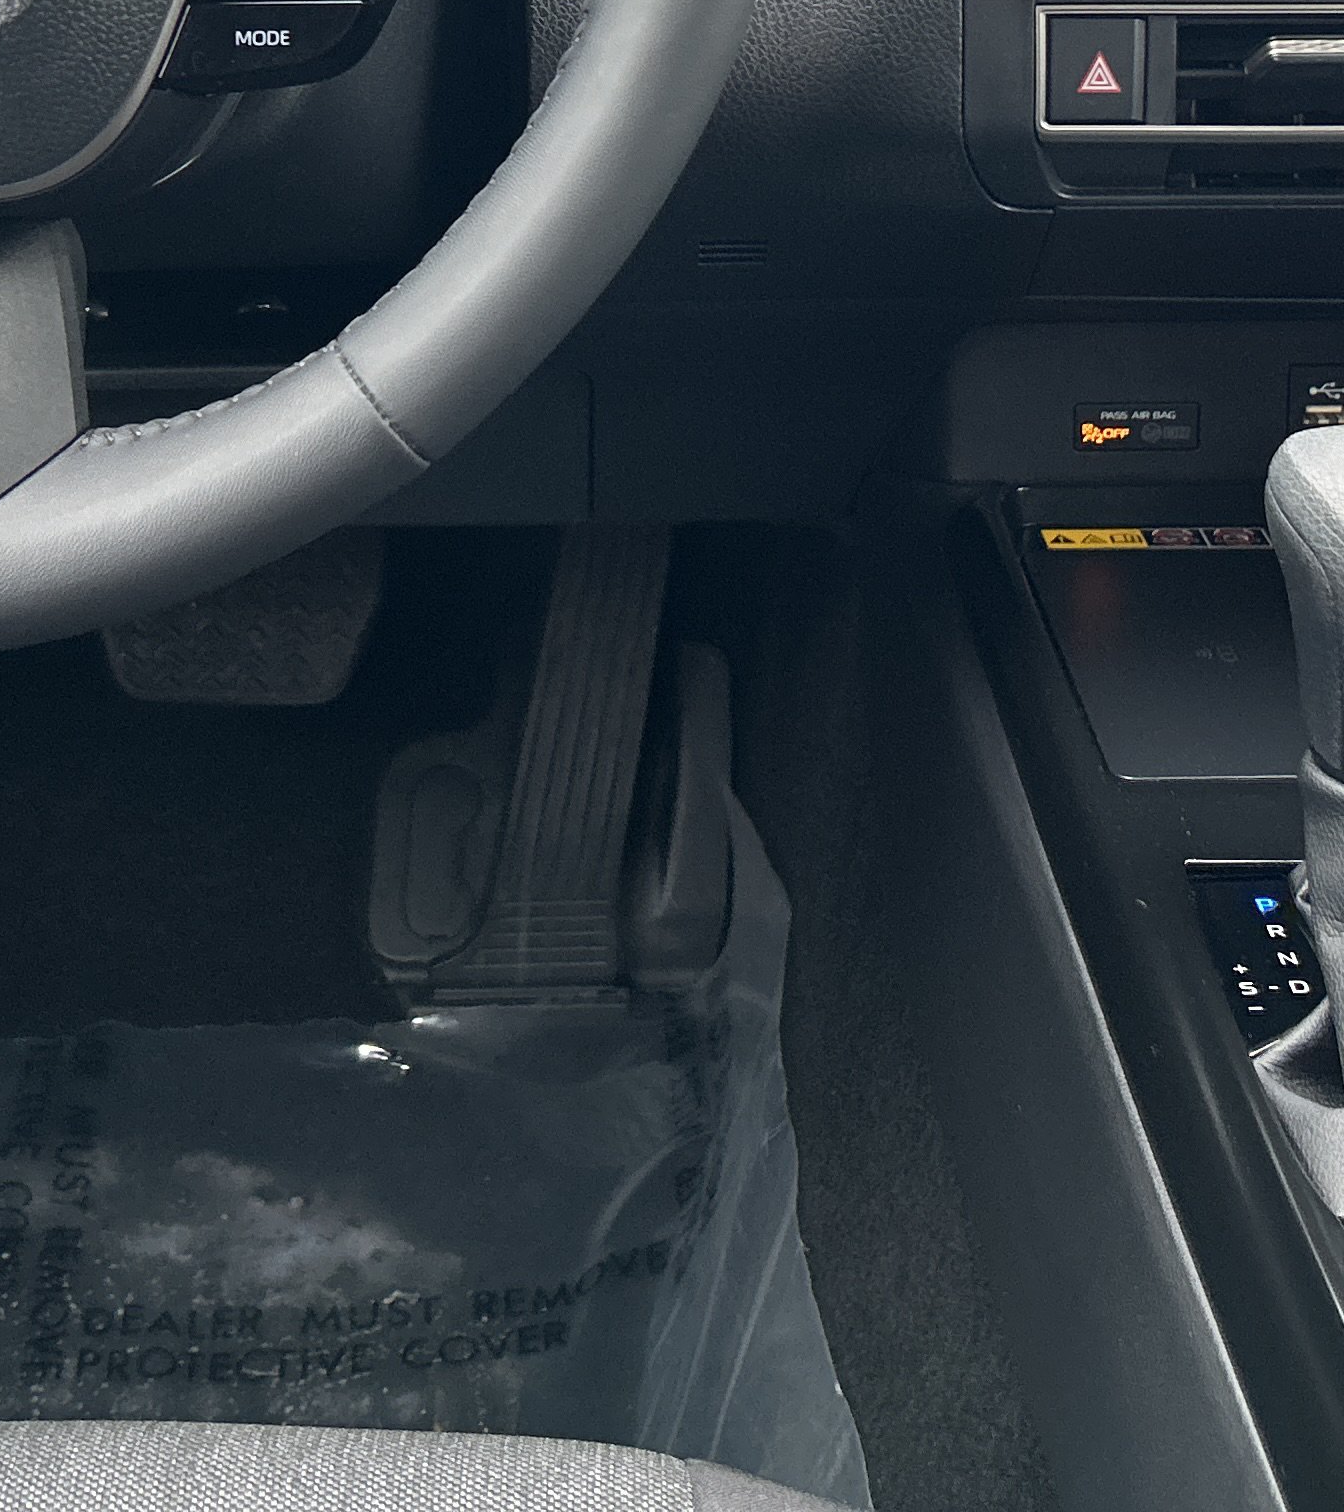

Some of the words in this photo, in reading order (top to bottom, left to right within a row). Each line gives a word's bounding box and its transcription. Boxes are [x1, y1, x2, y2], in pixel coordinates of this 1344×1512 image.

[235, 30, 291, 47] MODE
[1100, 410, 1128, 420] PASS
[1131, 410, 1150, 420] AIR
[1152, 410, 1176, 420] BAG
[1103, 428, 1130, 439] OFF
[1255, 898, 1279, 916] P
[1266, 924, 1287, 938] R
[1276, 951, 1300, 966] N
[1238, 981, 1258, 996] S
[1288, 979, 1310, 994] D
[80, 1304, 263, 1340] DEALER
[300, 1296, 444, 1335] MUST
[471, 1239, 676, 1322] REMOVE
[77, 1336, 370, 1385] PROTECTIVE
[401, 1319, 570, 1369] COVER
